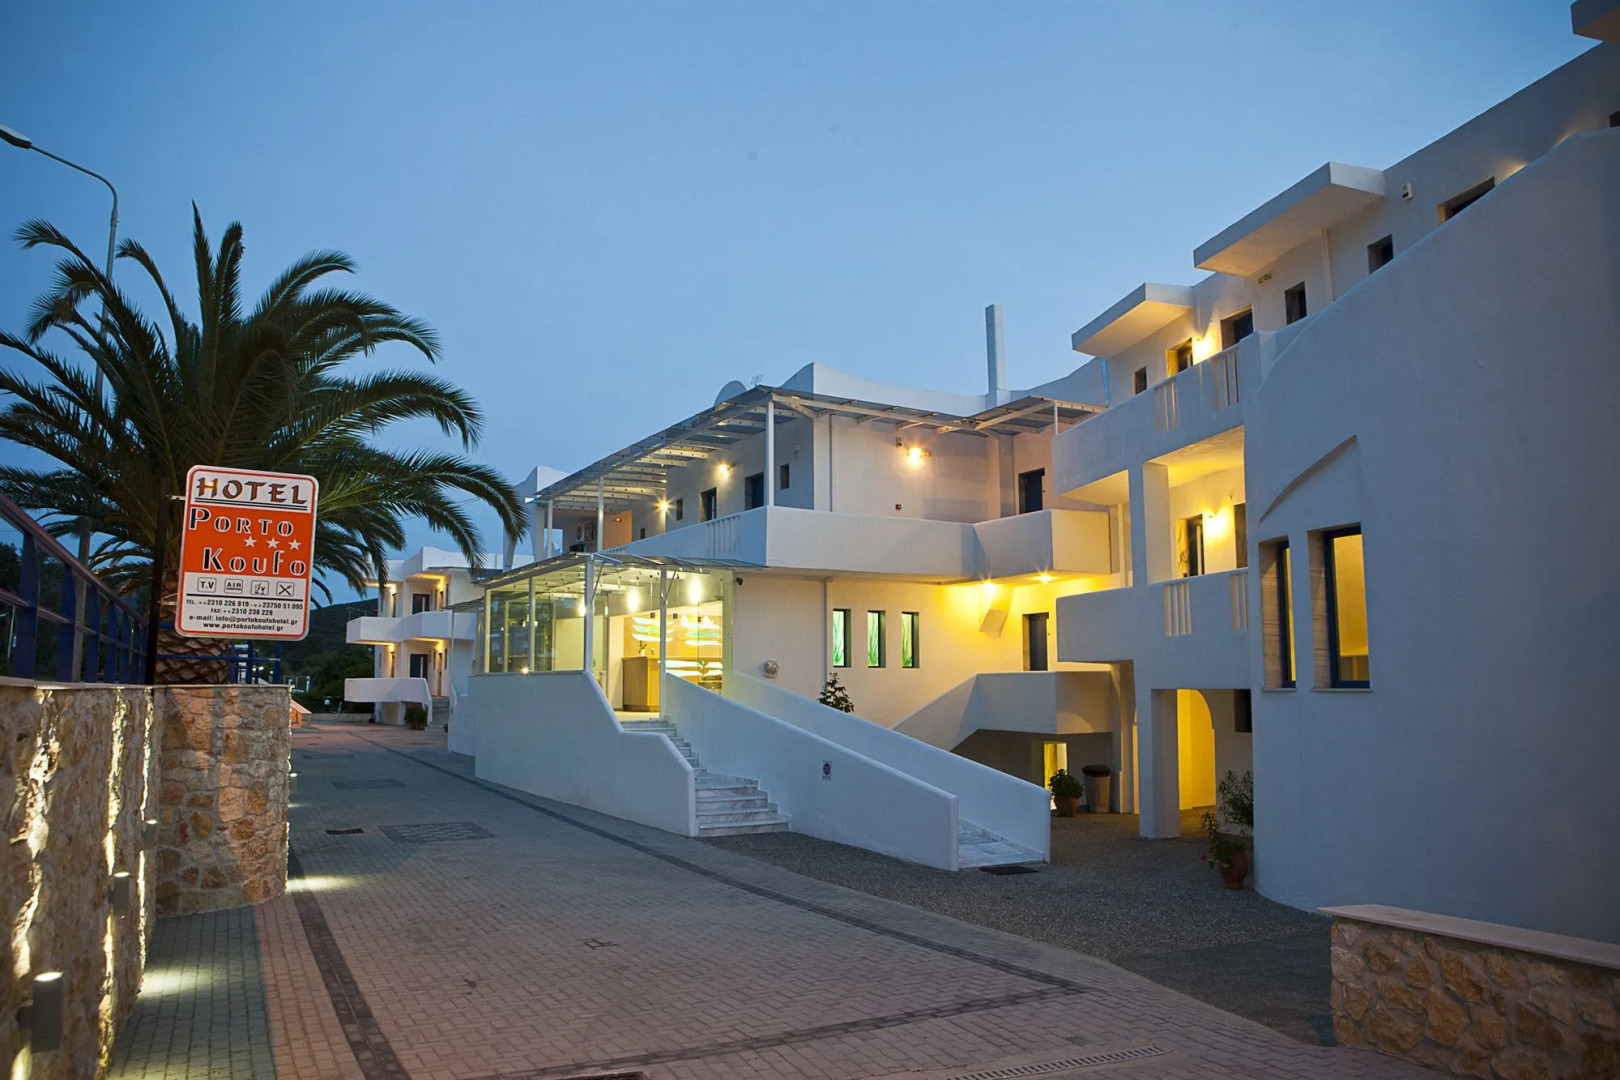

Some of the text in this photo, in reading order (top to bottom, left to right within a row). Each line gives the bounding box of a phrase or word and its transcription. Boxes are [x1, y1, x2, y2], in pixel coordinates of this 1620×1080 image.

[196, 478, 307, 504] HOTEL
[202, 546, 306, 576] Koufo
[216, 616, 298, 625] info@portokoufohotel.gr
